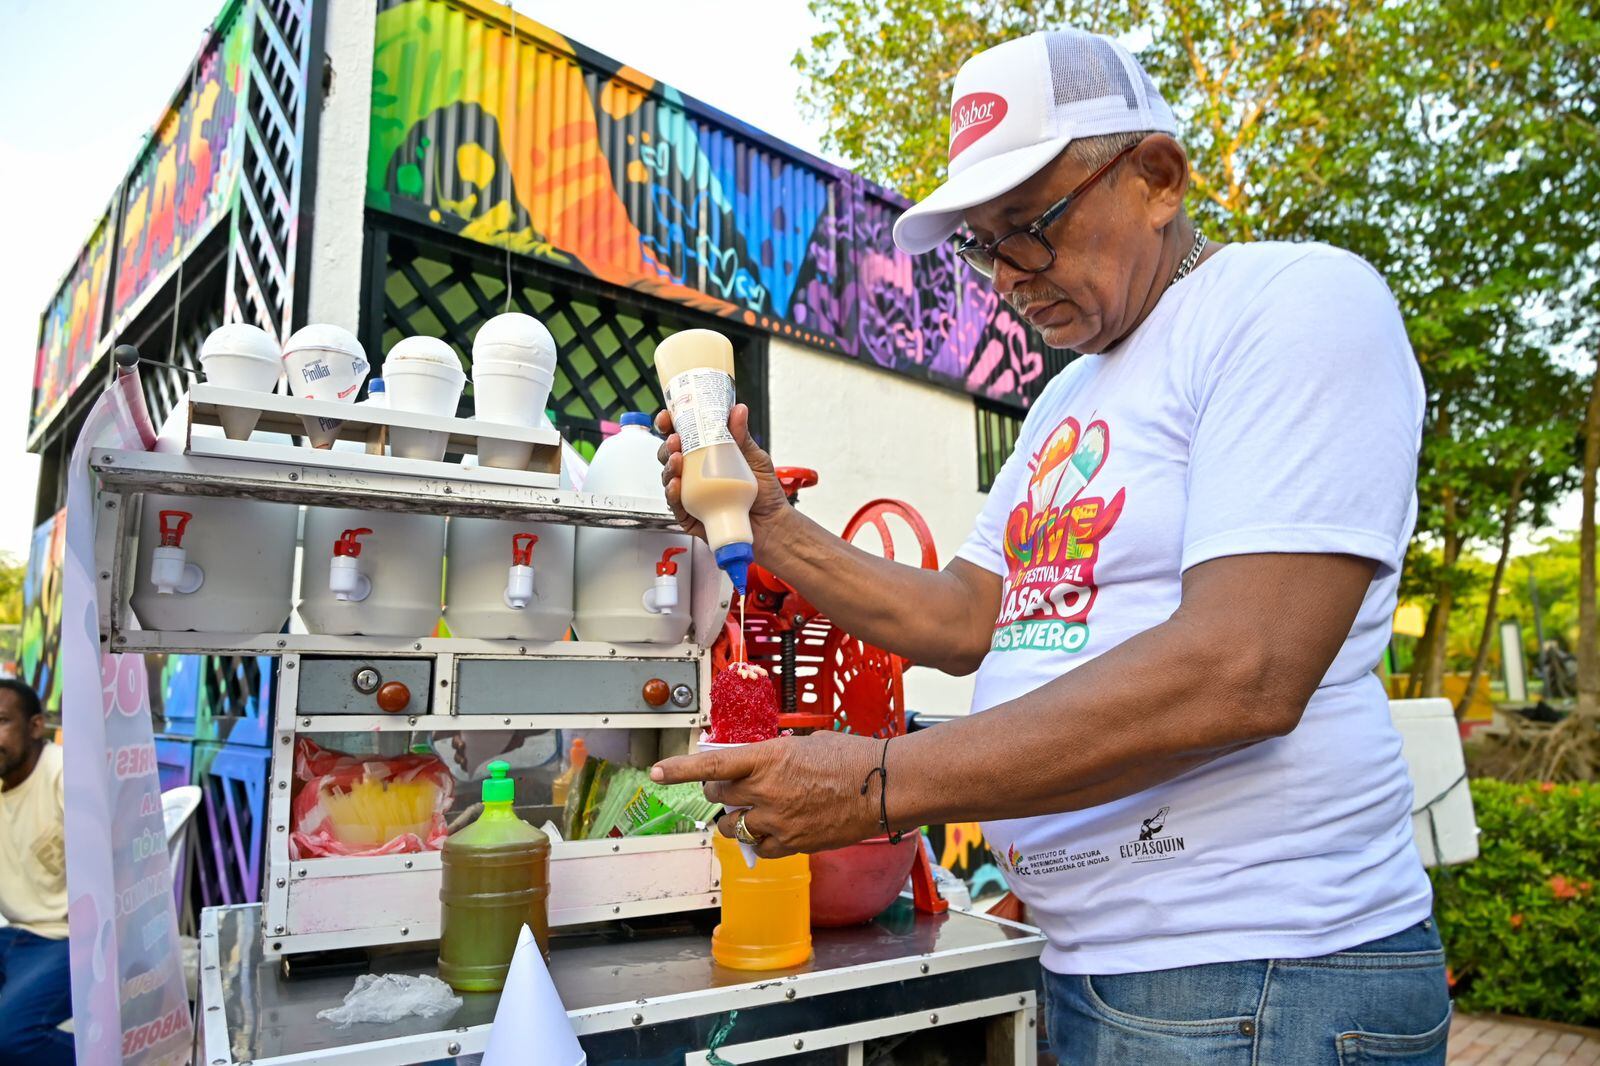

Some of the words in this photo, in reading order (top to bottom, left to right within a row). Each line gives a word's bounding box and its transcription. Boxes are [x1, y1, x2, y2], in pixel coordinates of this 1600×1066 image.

[959, 100, 996, 128] Sabor
[301, 363, 331, 384] Pinillar
[1022, 566, 1059, 585] FESTIVAL
[1057, 564, 1083, 583] DEL
[1027, 850, 1058, 862] INSTITUTO
[1030, 857, 1064, 868] PATRIMONIO
[1070, 850, 1101, 861] CULTURA
[1042, 863, 1076, 874] CARTAGENA
[1077, 860, 1086, 868] DE
[1086, 855, 1110, 866] INDIAS
